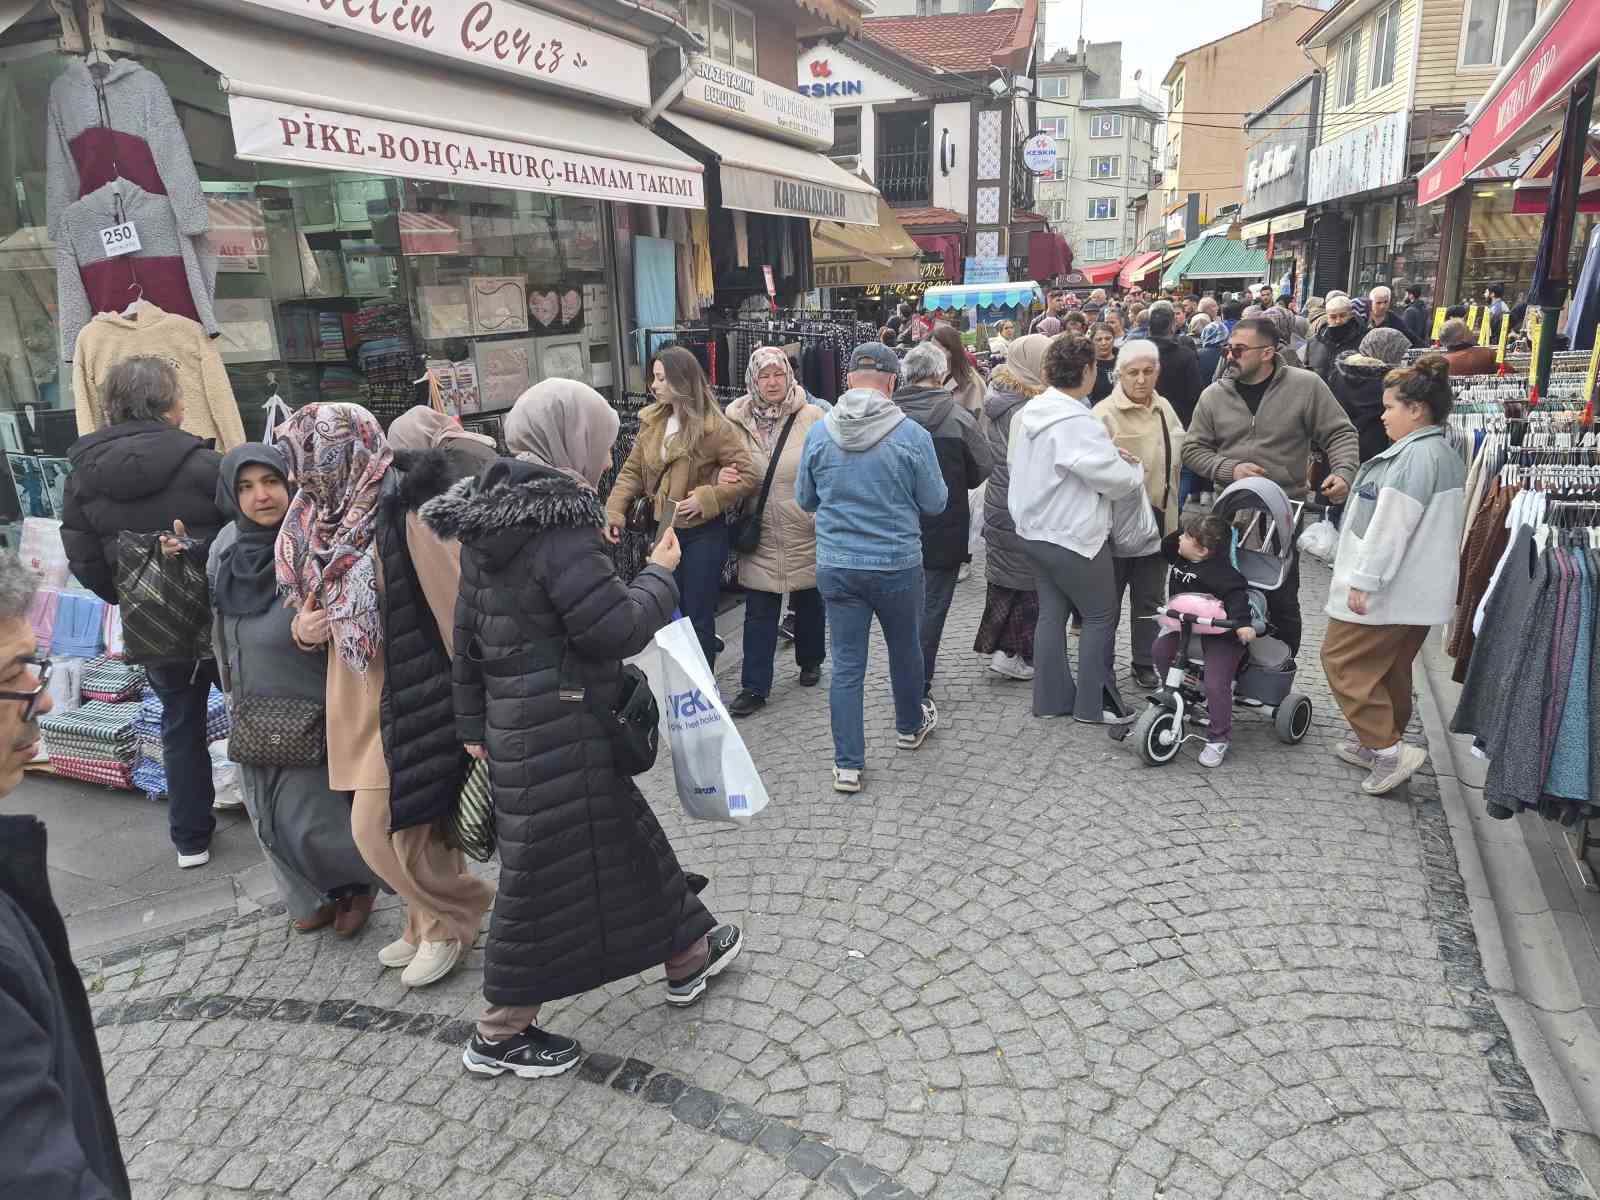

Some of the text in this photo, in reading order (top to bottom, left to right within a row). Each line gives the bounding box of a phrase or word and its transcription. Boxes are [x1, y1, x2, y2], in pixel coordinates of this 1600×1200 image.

[799, 80, 862, 98] ESKIN
[637, 172, 694, 197] TAKIMI
[104, 226, 131, 244] 250
